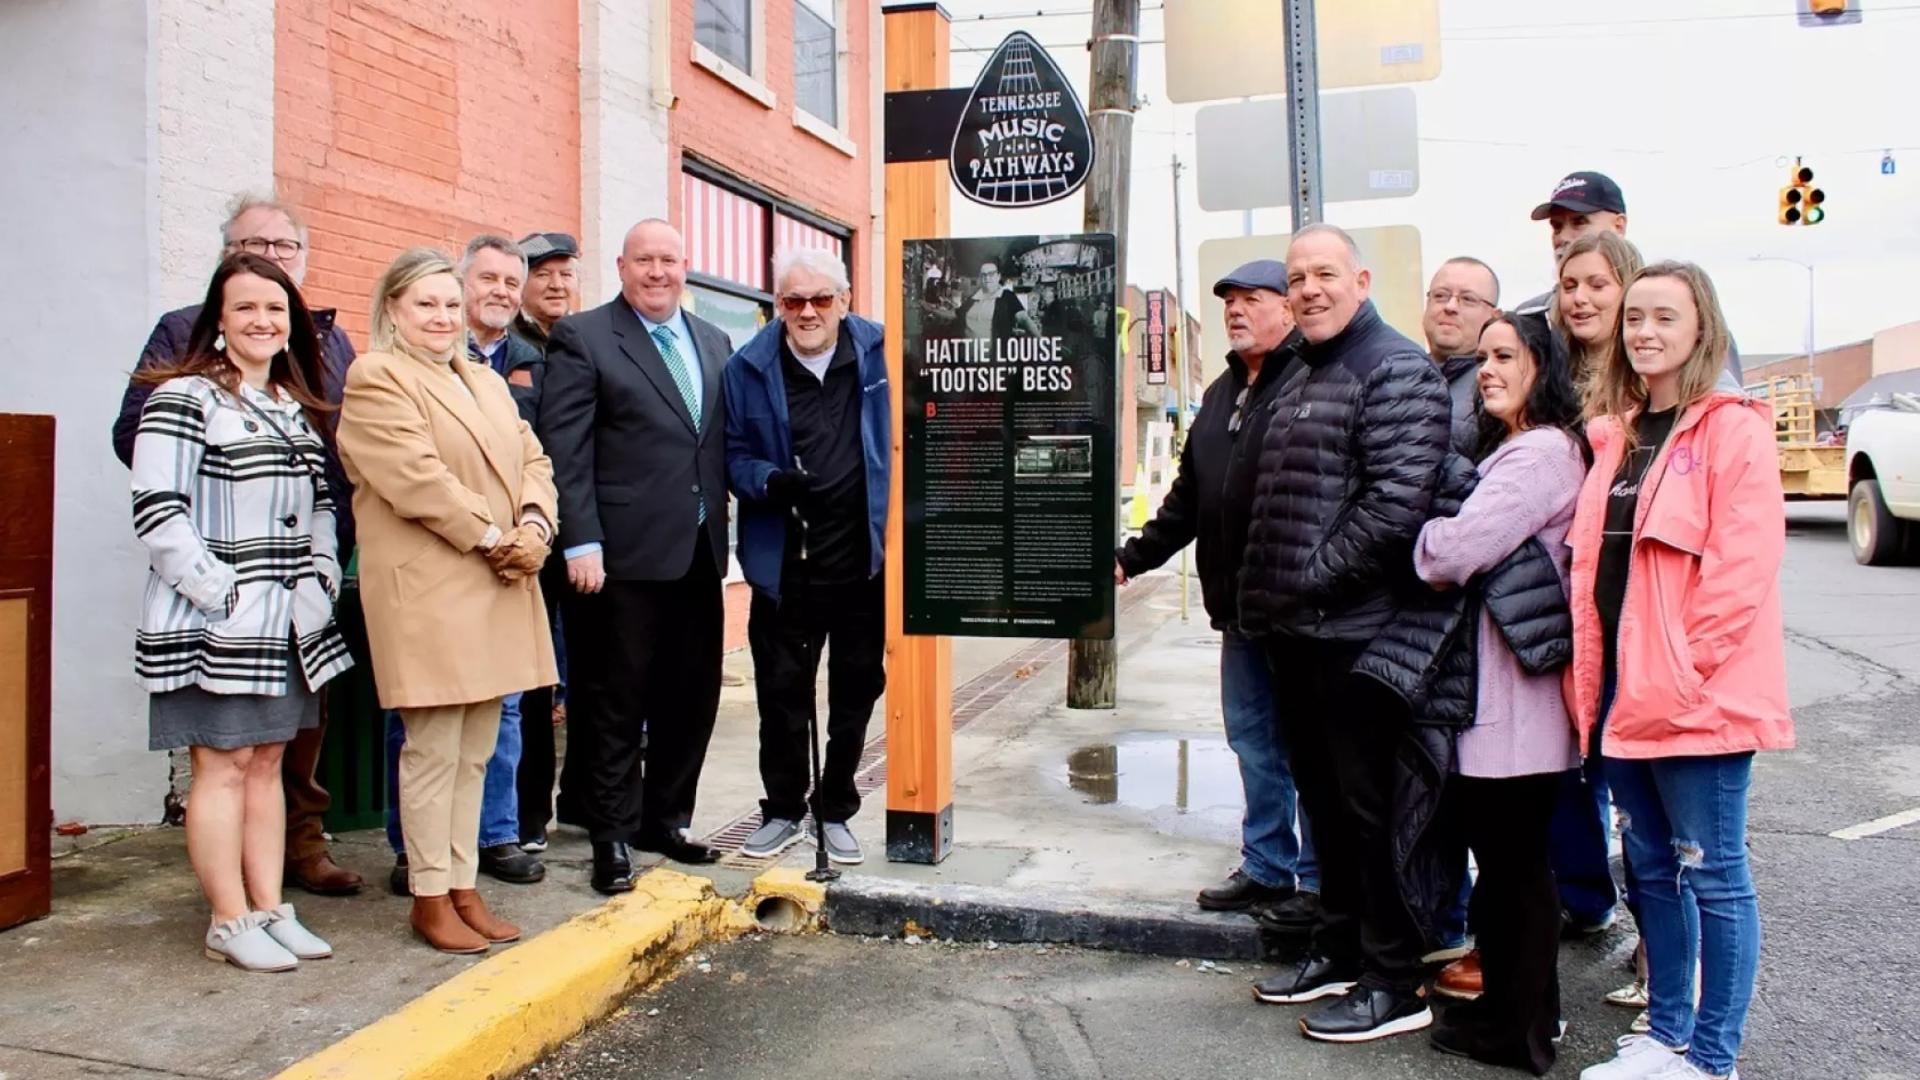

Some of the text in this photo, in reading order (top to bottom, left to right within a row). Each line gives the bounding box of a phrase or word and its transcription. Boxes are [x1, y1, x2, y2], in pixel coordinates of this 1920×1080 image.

[979, 91, 1062, 113] TENNESSEE
[977, 118, 1066, 149] MUSIC
[969, 152, 1075, 179] PATHWAYS
[925, 336, 1063, 364] HATTIE LOUISE
[1023, 365, 1073, 391] BESS
